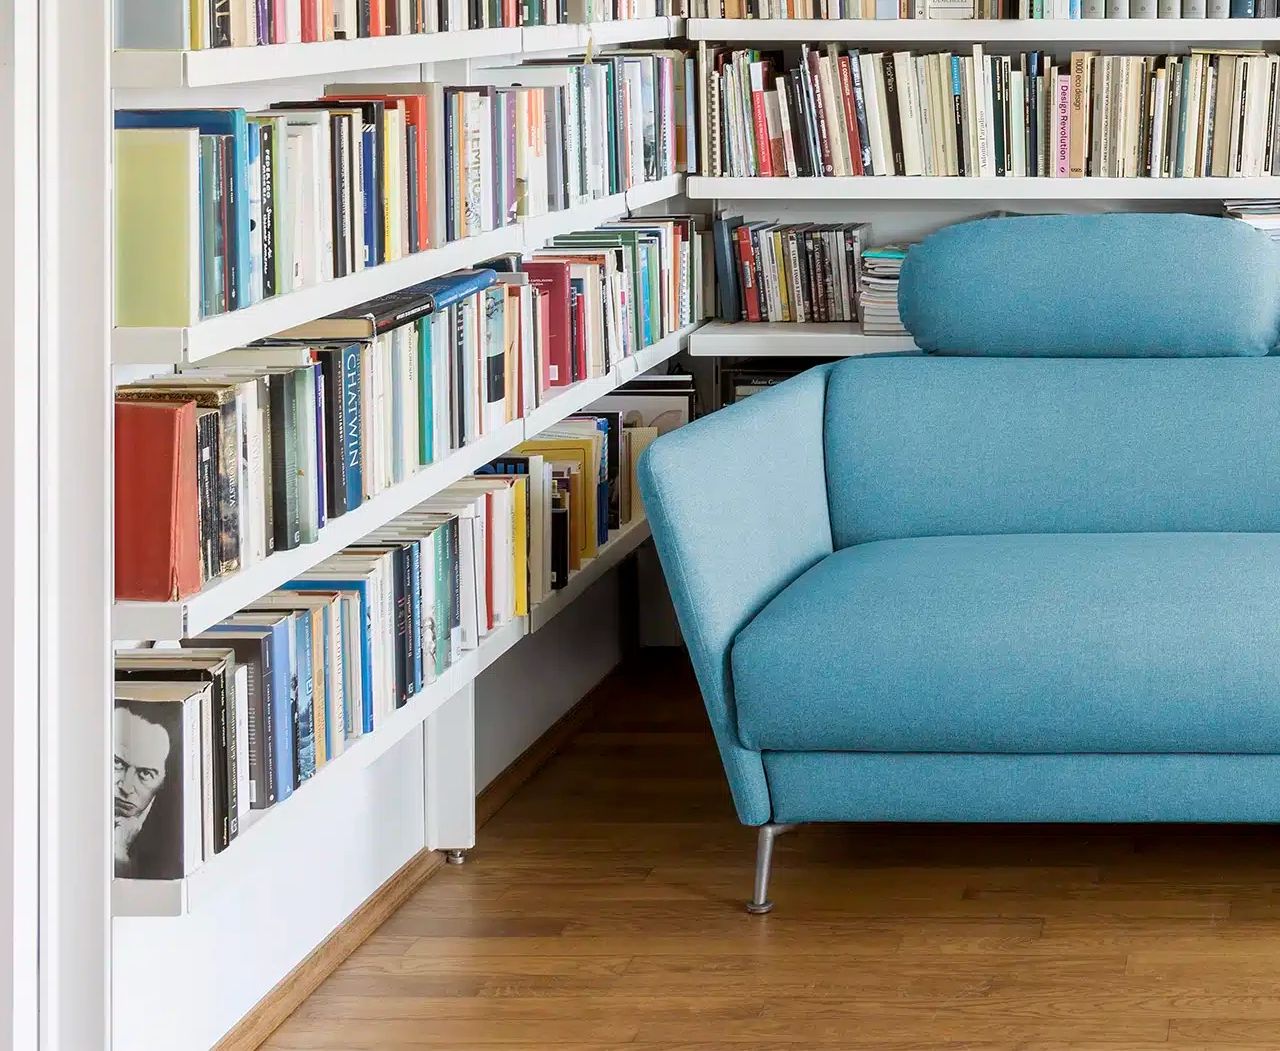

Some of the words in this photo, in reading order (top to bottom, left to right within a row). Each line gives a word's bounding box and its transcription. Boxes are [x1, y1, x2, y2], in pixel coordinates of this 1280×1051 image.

[1075, 58, 1083, 74] 1000
[1059, 85, 1068, 114] Design
[1074, 88, 1083, 111] design
[1060, 115, 1068, 161] Revolution
[347, 353, 359, 467] CHATWIN
